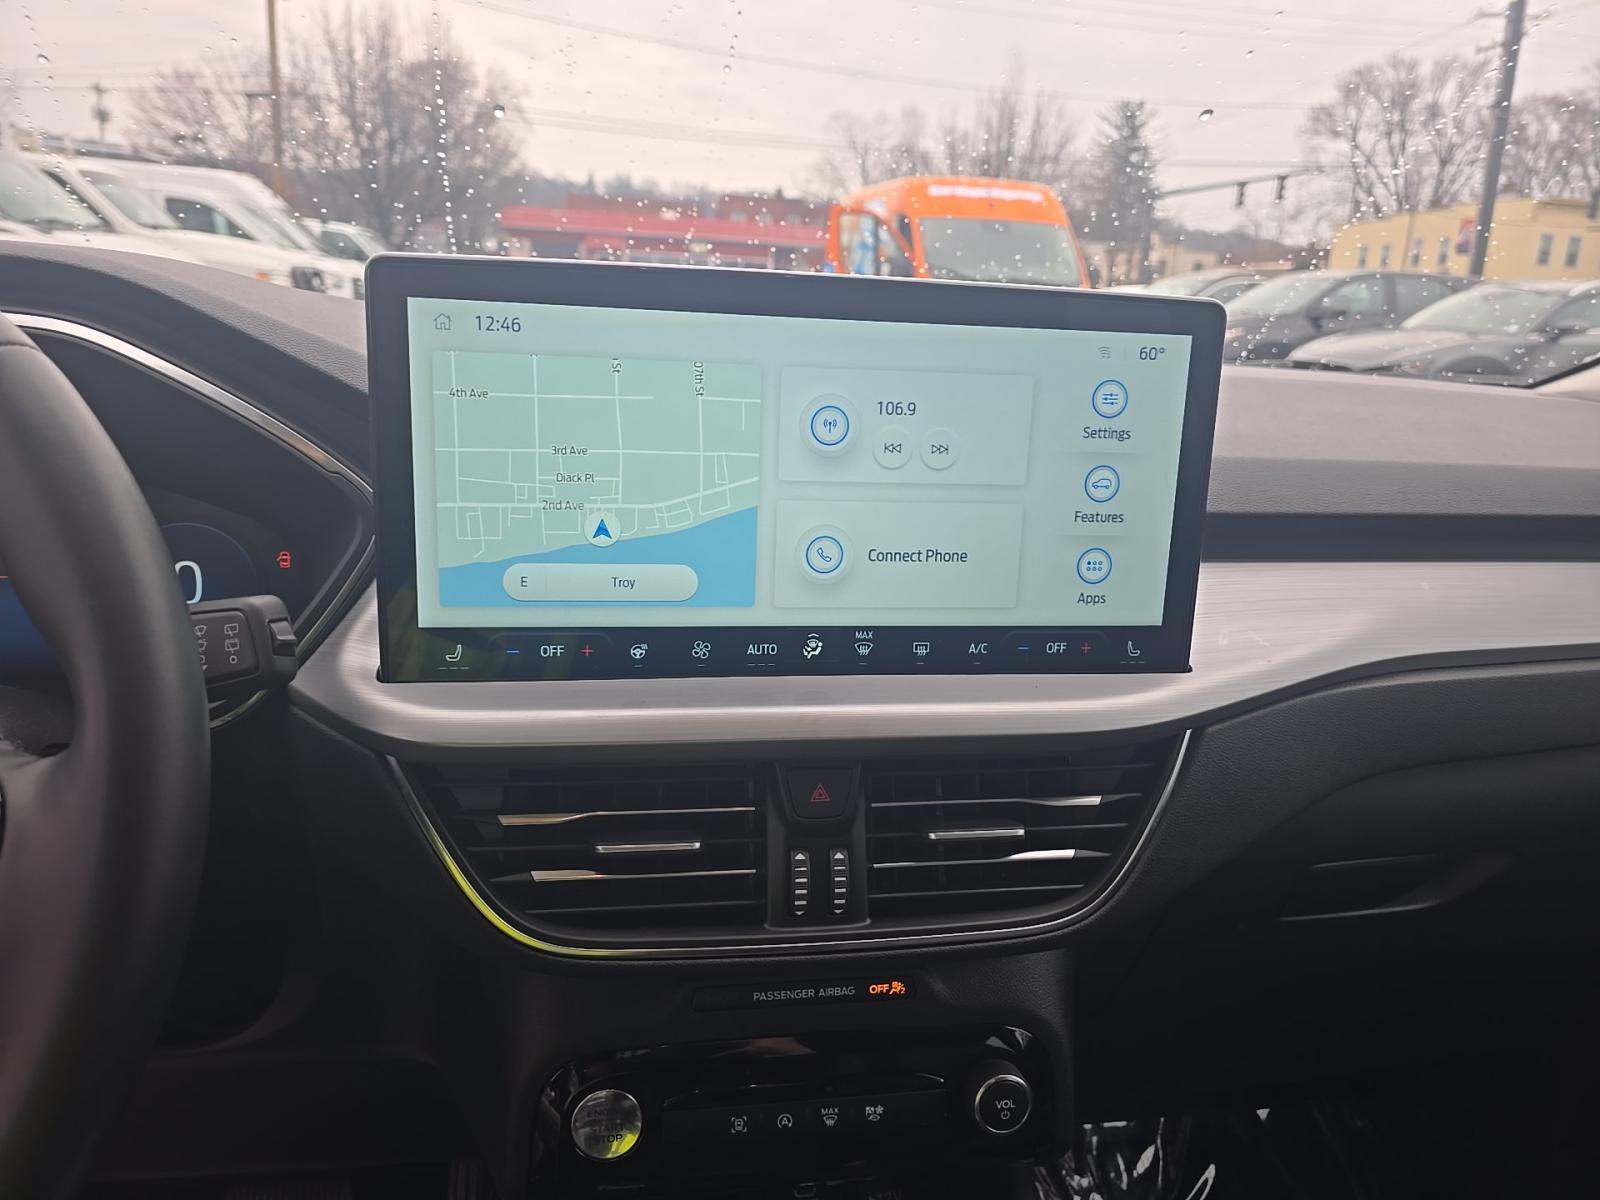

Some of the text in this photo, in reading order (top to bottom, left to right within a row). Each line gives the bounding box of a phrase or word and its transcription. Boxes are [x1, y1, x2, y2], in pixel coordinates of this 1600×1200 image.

[475, 315, 521, 333] 12:46
[1139, 346, 1166, 361] 60°
[449, 387, 489, 399] 4th Ave
[695, 386, 705, 397] St
[877, 401, 917, 416] 106.9
[1082, 426, 1132, 442] Settings
[551, 445, 588, 456] 3rd Ave
[556, 472, 595, 484] Diack Pl
[542, 499, 584, 511] 2nd Ave
[1074, 510, 1125, 524] Features
[868, 548, 968, 563] Connect Phone
[520, 576, 528, 588] E
[611, 576, 636, 590] Troy
[1077, 592, 1106, 606] Apps
[855, 630, 873, 639] MAX
[540, 644, 565, 657] OFF
[747, 643, 778, 655] AUTO
[968, 642, 988, 655] A/C
[1046, 642, 1067, 654] OFF
[753, 988, 815, 1001] PASSENGER
[818, 986, 856, 998] AIRBAG
[869, 983, 890, 995] OFF
[996, 1100, 1016, 1109] VOL
[821, 1107, 839, 1115] MAX
